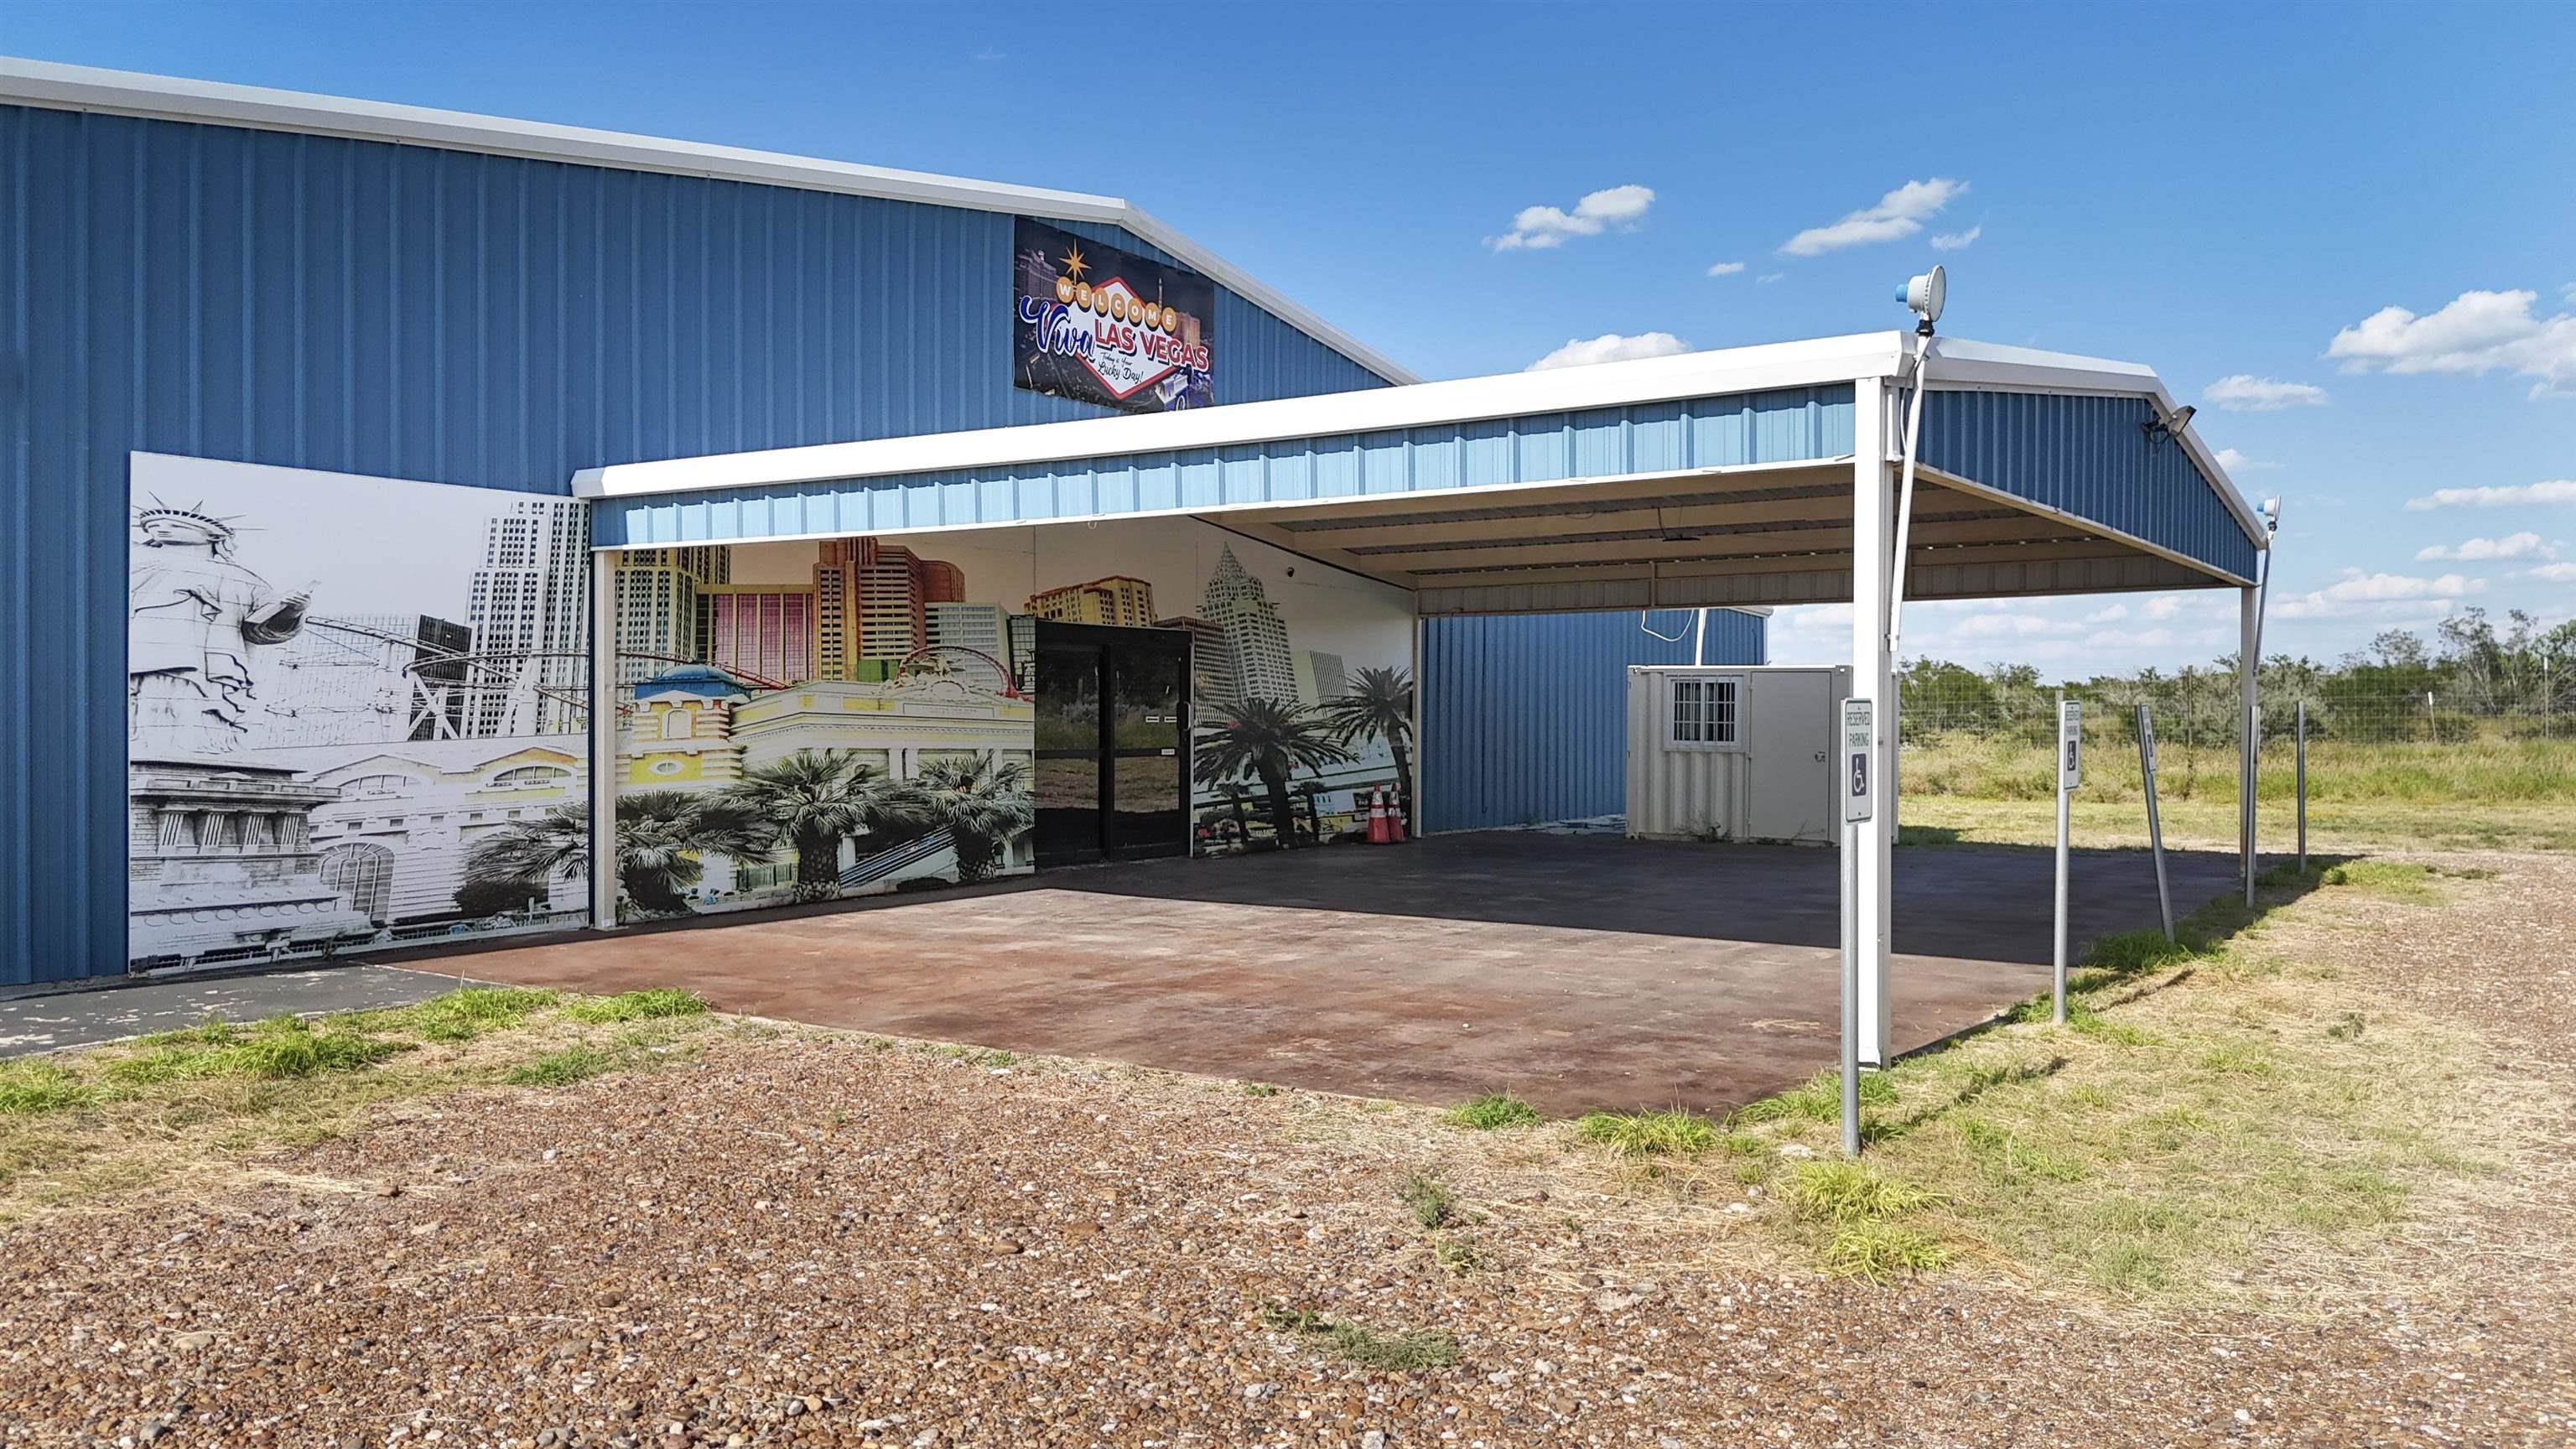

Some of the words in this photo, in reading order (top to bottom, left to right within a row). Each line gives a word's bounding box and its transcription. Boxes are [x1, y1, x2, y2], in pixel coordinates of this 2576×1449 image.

[1058, 285, 1172, 326] WELCOME
[1020, 295, 1094, 361] Viva
[1094, 319, 1135, 351] LAS
[1140, 330, 1209, 370] VEGAS
[1098, 361, 1120, 381] Lucky
[1123, 367, 1144, 384] Day!
[1846, 711, 1871, 726] RESERVED
[1849, 732, 1869, 747] PARKING
